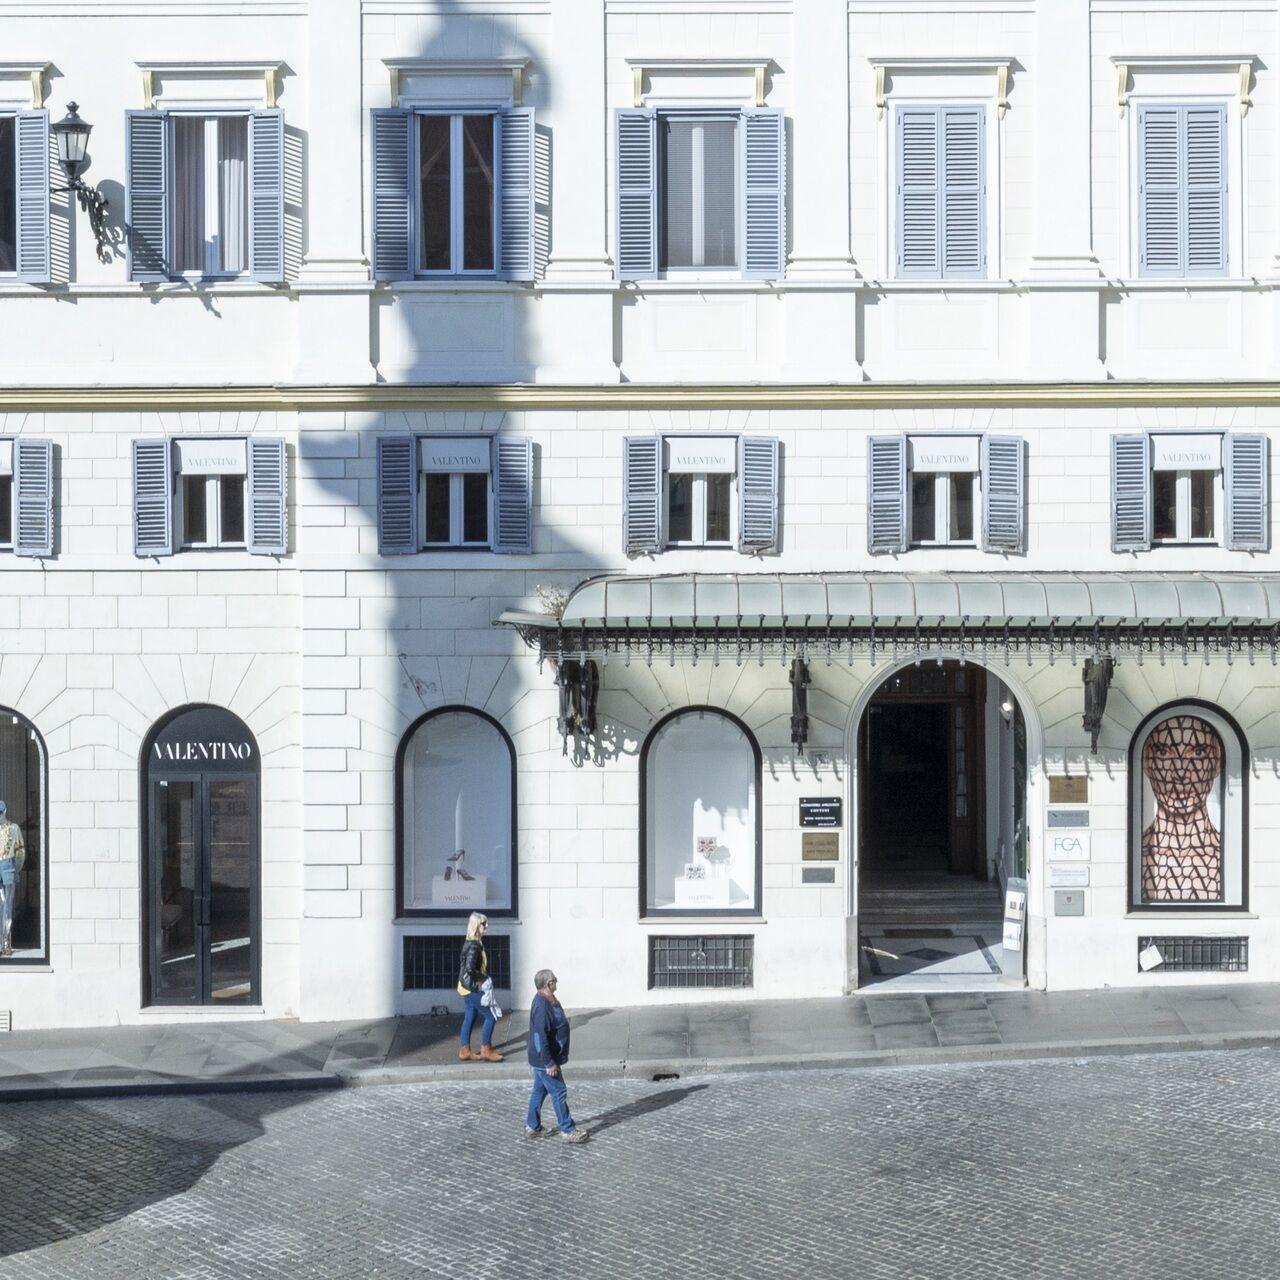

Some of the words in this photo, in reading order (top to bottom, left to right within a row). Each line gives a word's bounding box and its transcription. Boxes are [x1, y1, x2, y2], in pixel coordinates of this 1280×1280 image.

[188, 457, 237, 467] VALENTINO
[432, 456, 481, 466] VALENTINO
[677, 456, 726, 465] VALENTINO
[920, 455, 969, 464] VALENTINO
[1163, 453, 1211, 462] VALENTINO
[154, 742, 251, 760] VALENTINO
